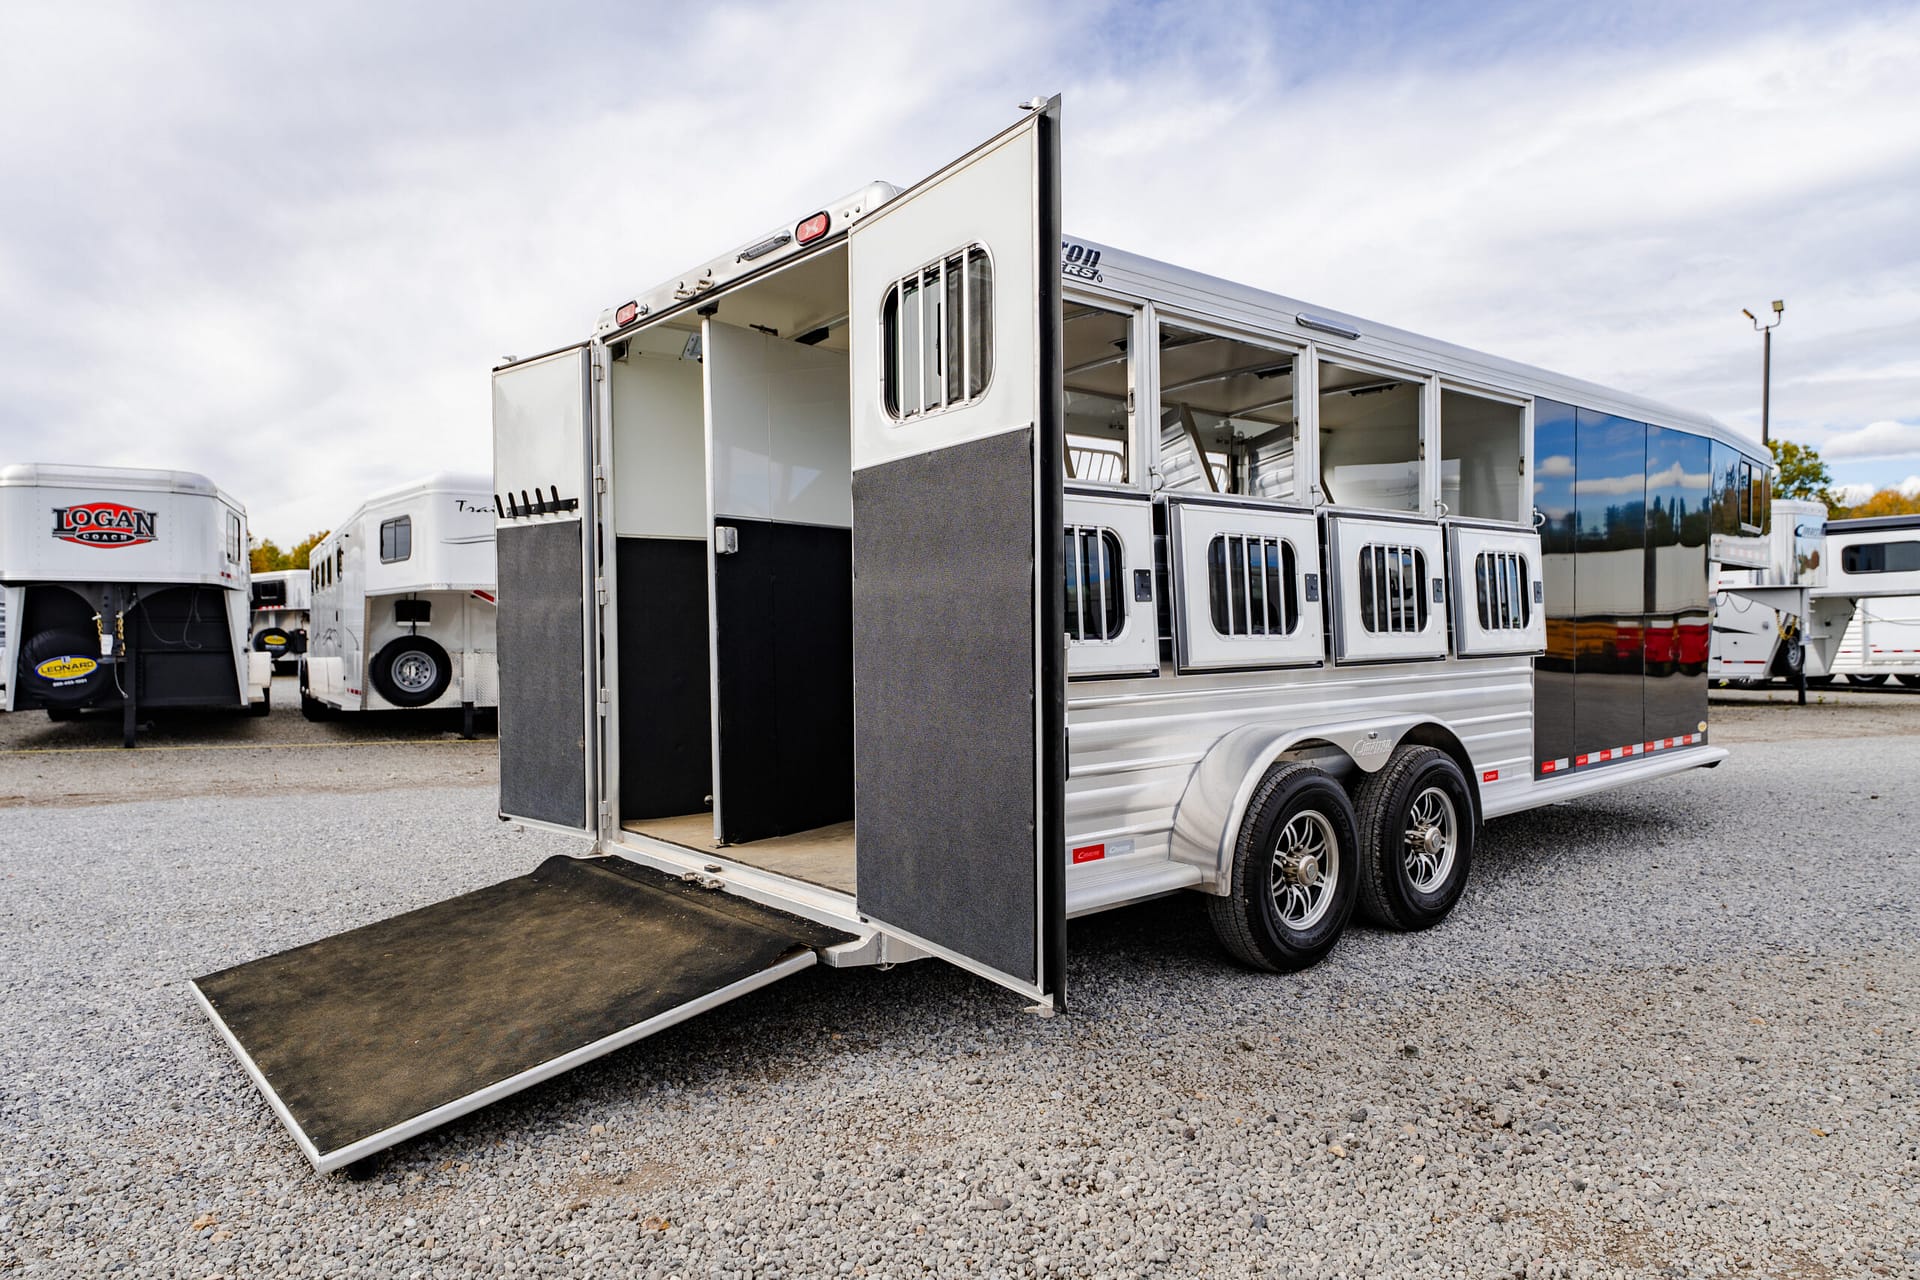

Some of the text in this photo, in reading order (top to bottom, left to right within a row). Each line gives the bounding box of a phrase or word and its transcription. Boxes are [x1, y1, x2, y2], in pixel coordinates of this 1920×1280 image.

[1062, 263, 1095, 279] RS
[52, 507, 158, 537] LOGAN
[82, 533, 128, 542] COACH
[40, 661, 94, 674] LEONARD
